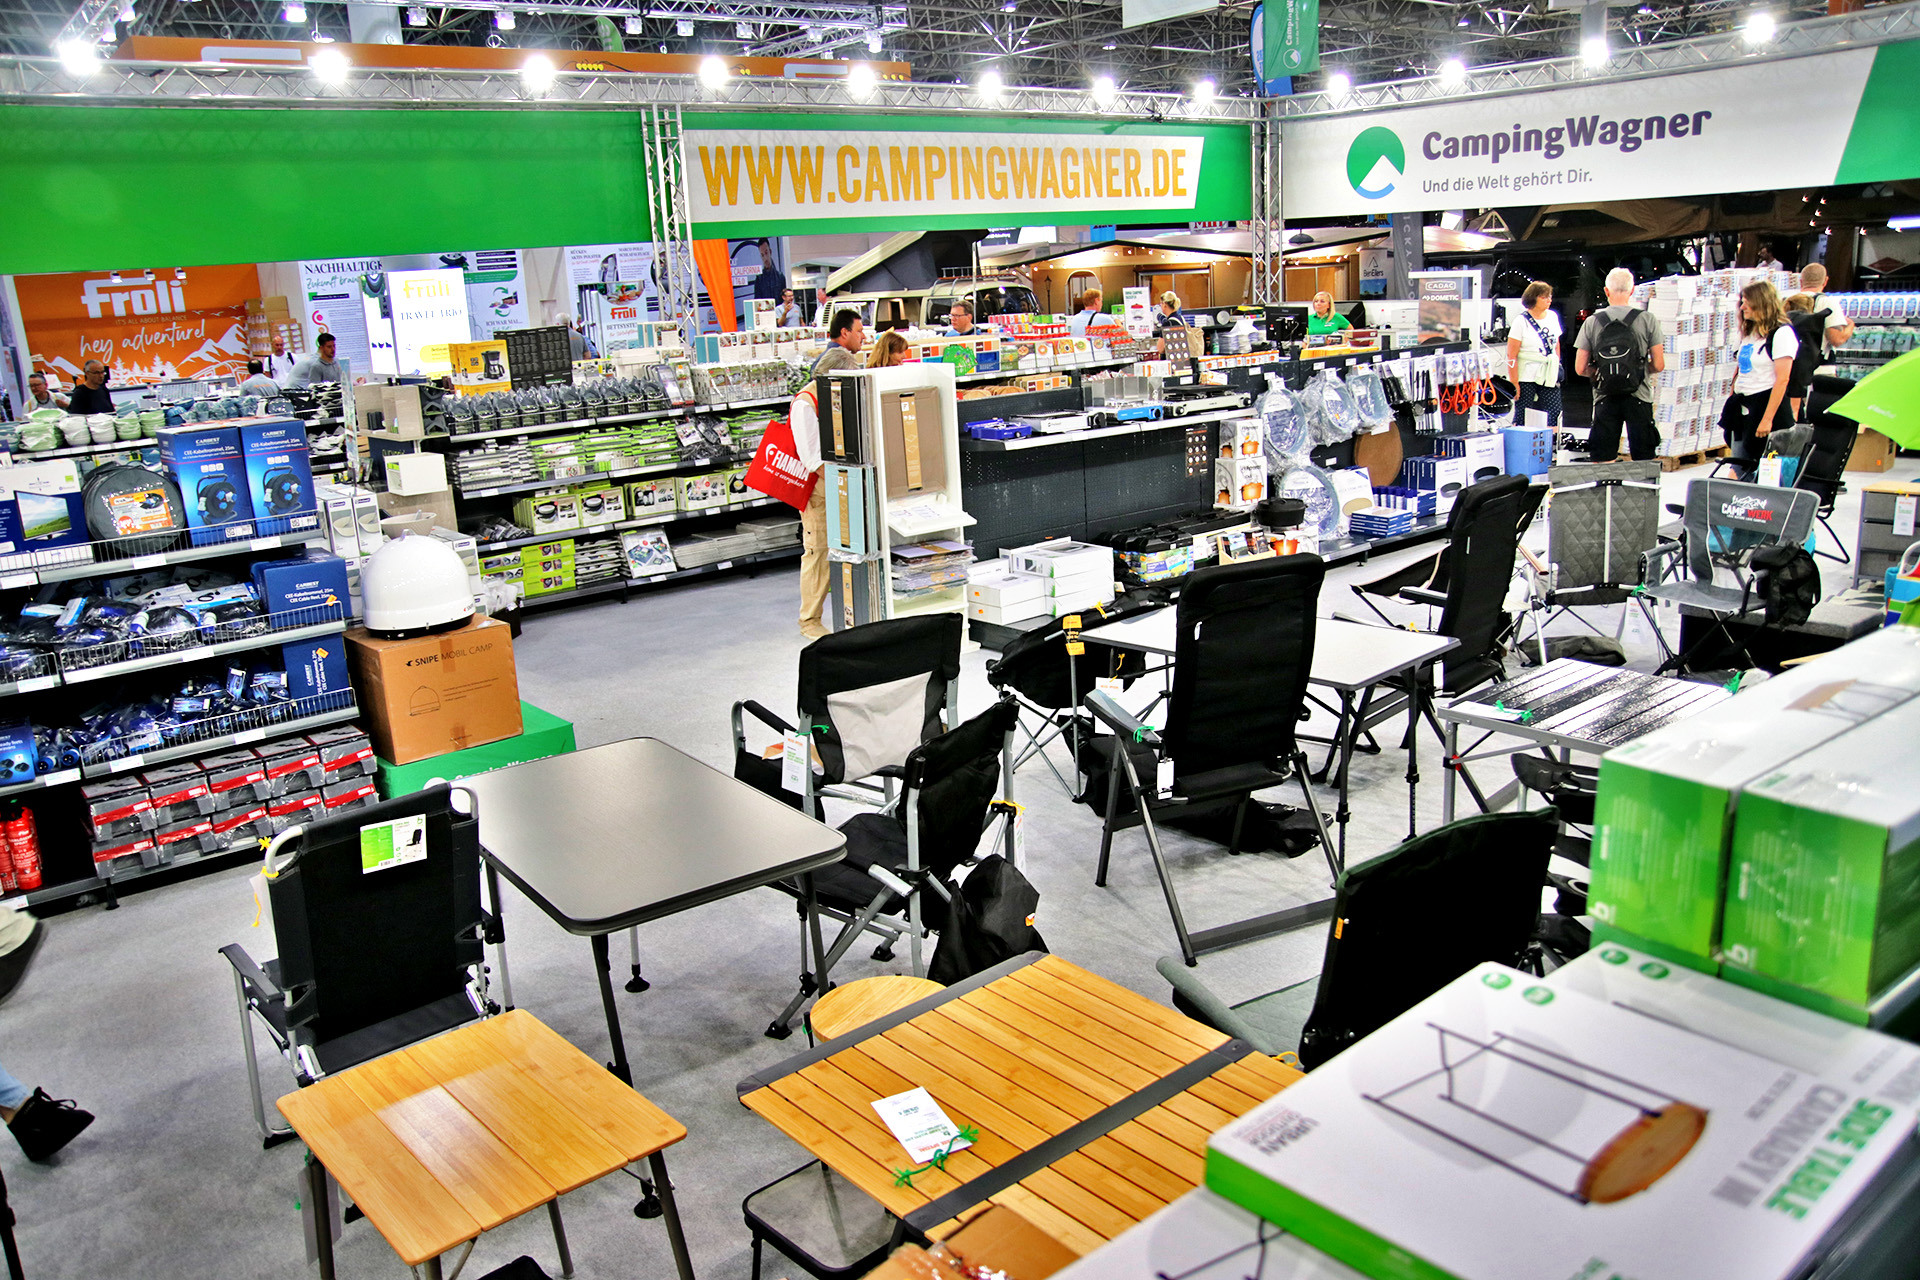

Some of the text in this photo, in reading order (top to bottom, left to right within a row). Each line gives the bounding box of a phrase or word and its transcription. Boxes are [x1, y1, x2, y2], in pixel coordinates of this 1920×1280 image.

[1422, 110, 1713, 164] CampingWagner
[699, 144, 1188, 206] WWW.CAMPINGWAGNER.DE
[1422, 169, 1593, 193] Und die Welt gehört Dir.
[79, 335, 114, 363] hey
[771, 449, 810, 481] FIAMMA
[1721, 503, 1774, 521] CAMP WERK
[415, 643, 494, 667] SNIPE MOBIL CAMP
[1826, 1099, 1894, 1152] SIDE
[1765, 1138, 1868, 1221] TABLE
